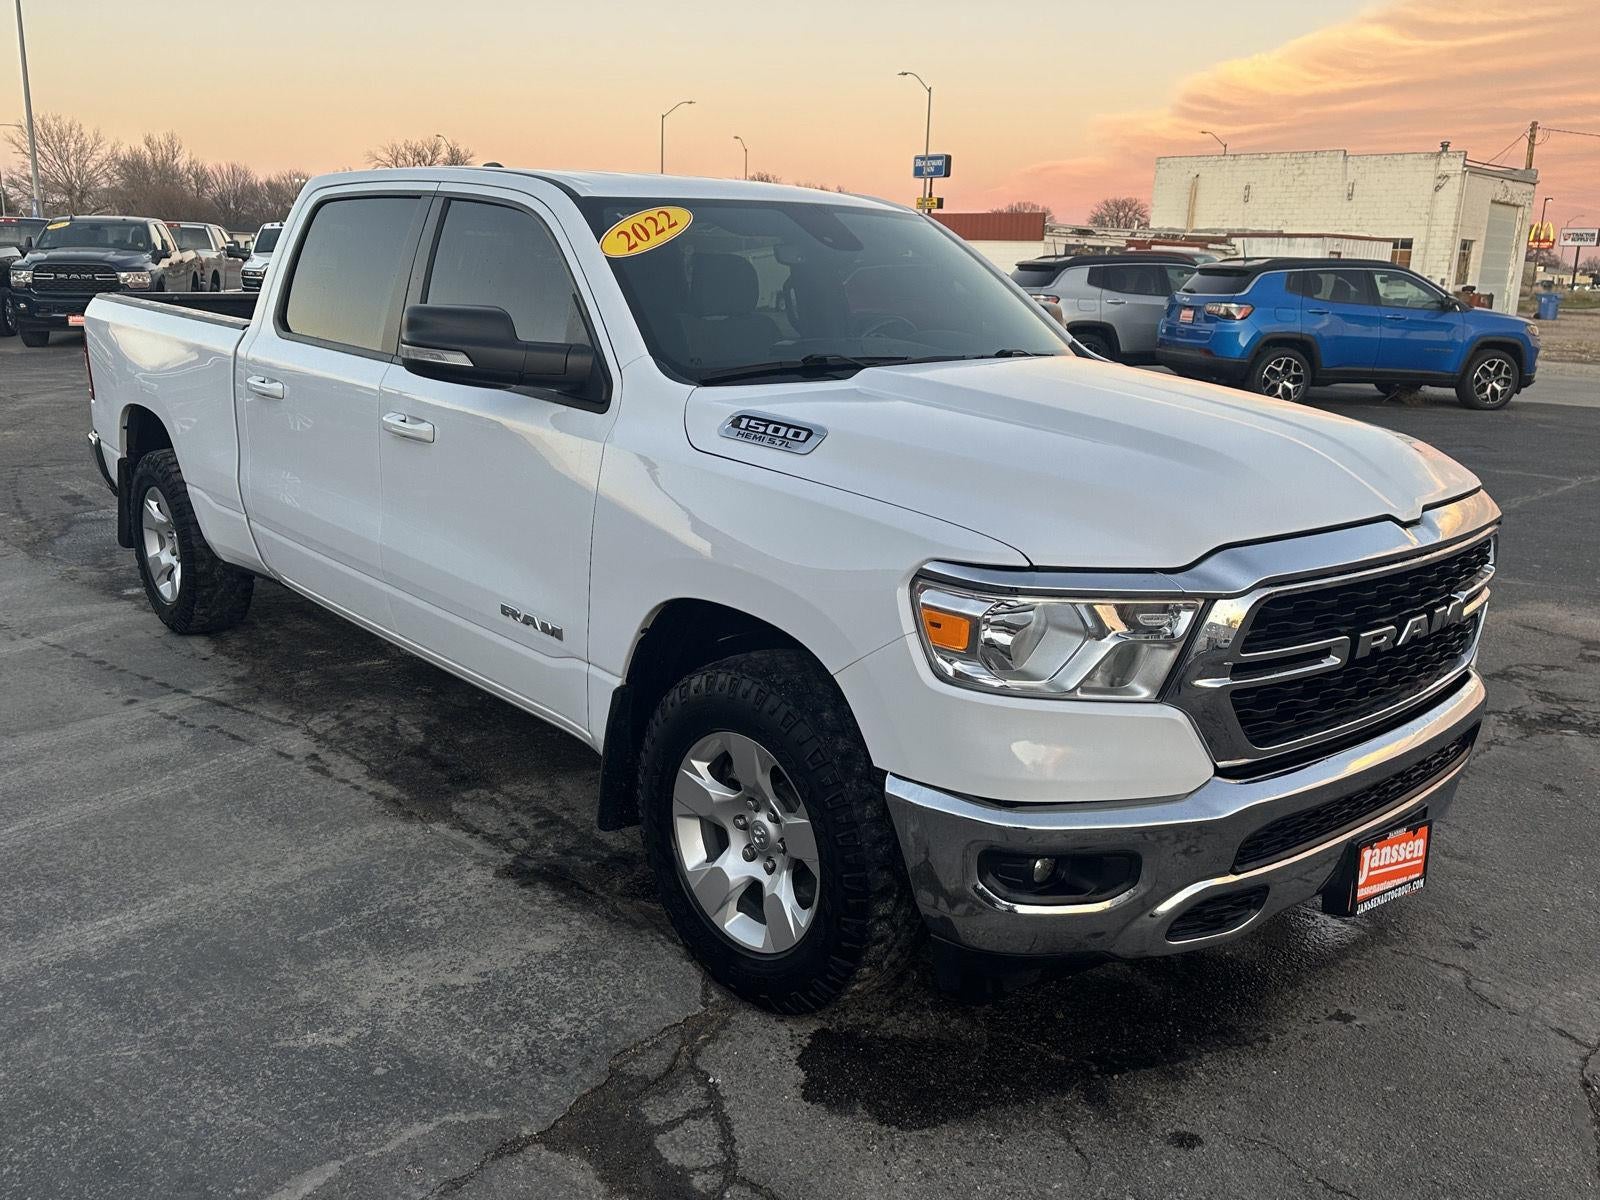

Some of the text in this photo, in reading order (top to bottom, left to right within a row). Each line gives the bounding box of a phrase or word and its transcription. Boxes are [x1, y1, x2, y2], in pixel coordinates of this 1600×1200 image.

[616, 210, 678, 252] 2022
[736, 430, 792, 449] HEMI 5.7L
[739, 418, 809, 440] 1500
[500, 602, 563, 641] RAM
[1355, 600, 1464, 659] RAM
[1358, 838, 1424, 886] Janssen
